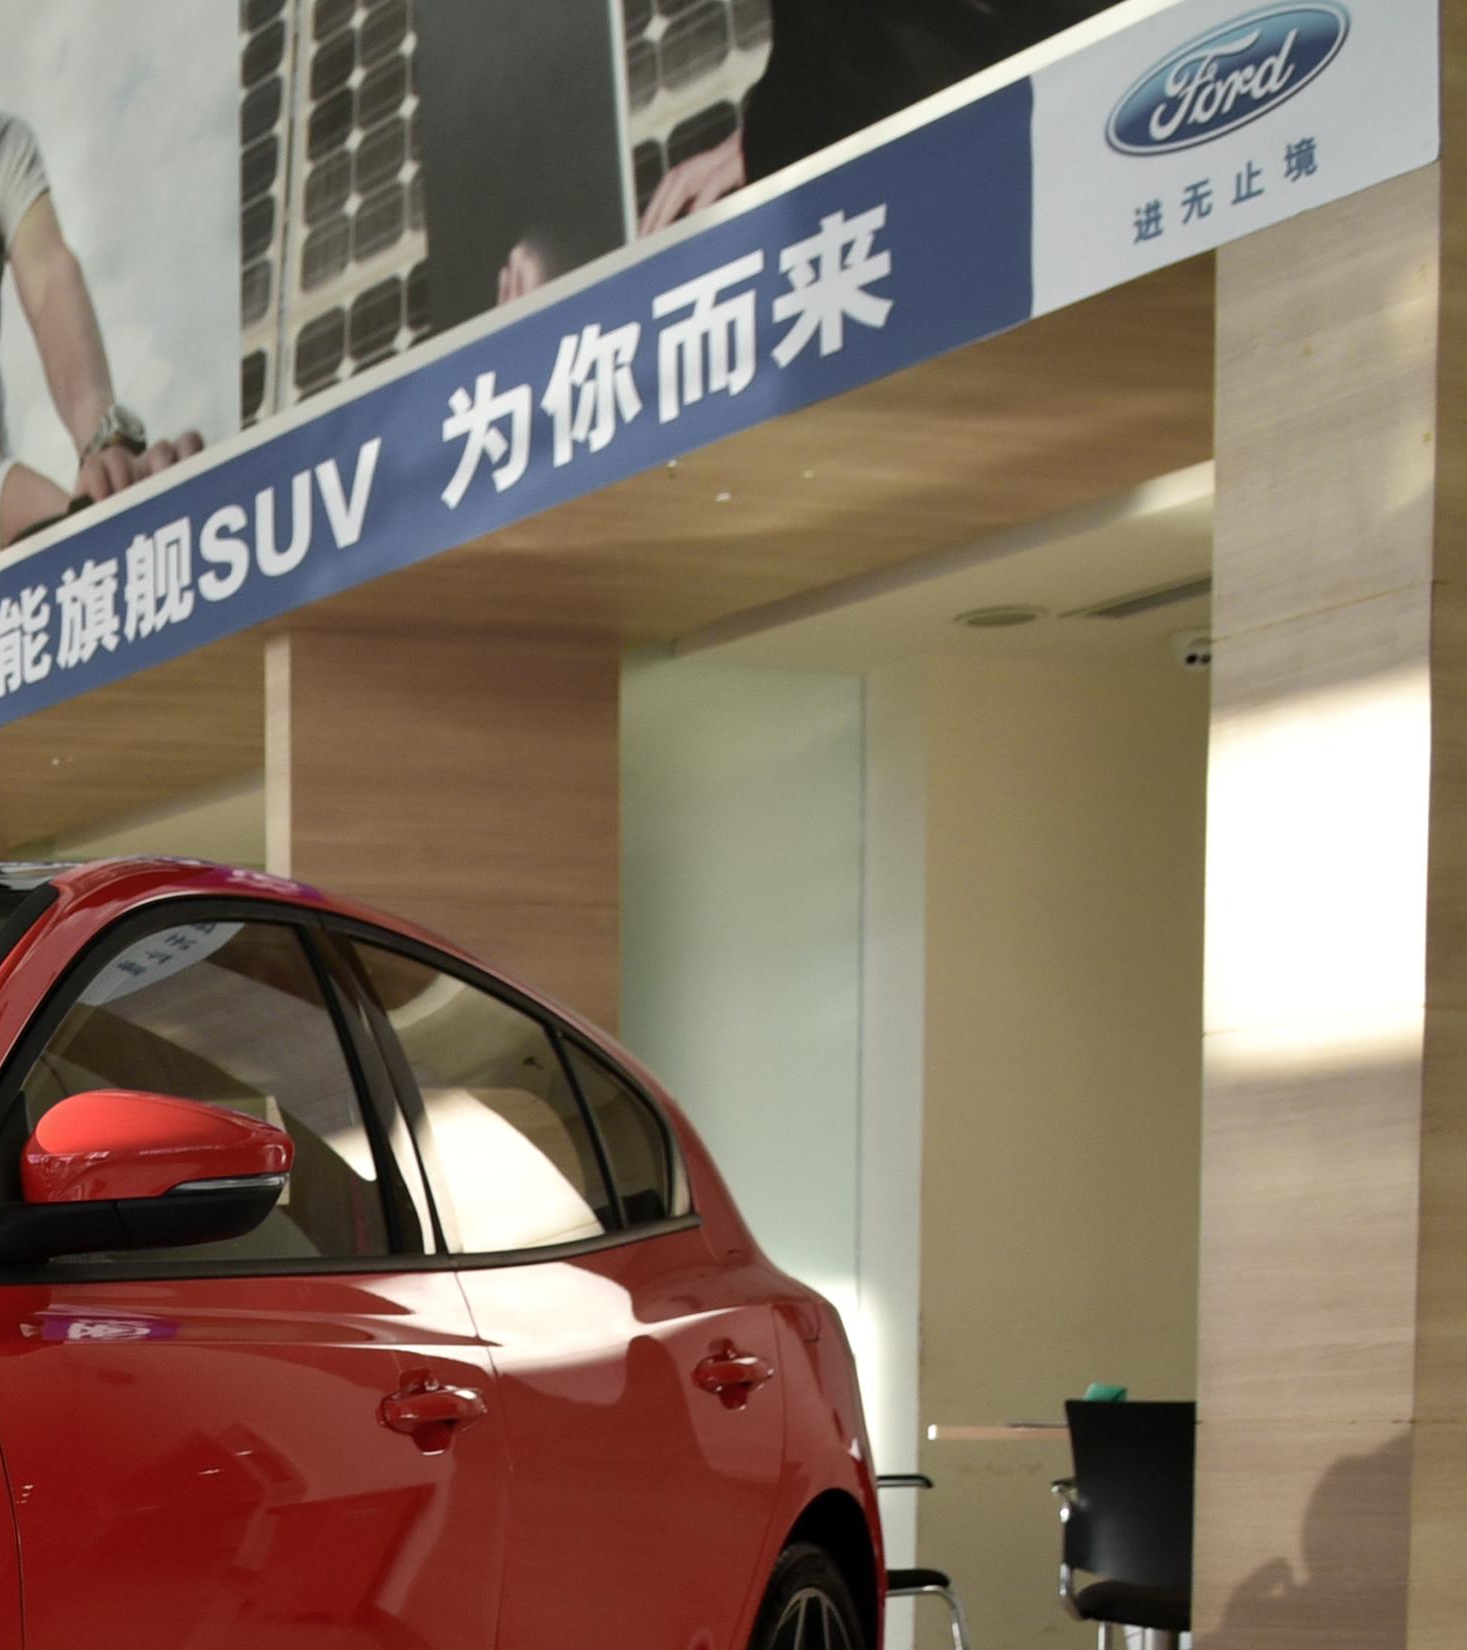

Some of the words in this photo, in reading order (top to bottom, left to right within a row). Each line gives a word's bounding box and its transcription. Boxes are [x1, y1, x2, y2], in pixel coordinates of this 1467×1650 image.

[1149, 33, 1297, 142] Ford
[1132, 137, 1320, 245] 进无止境
[440, 204, 894, 510] 为你而来
